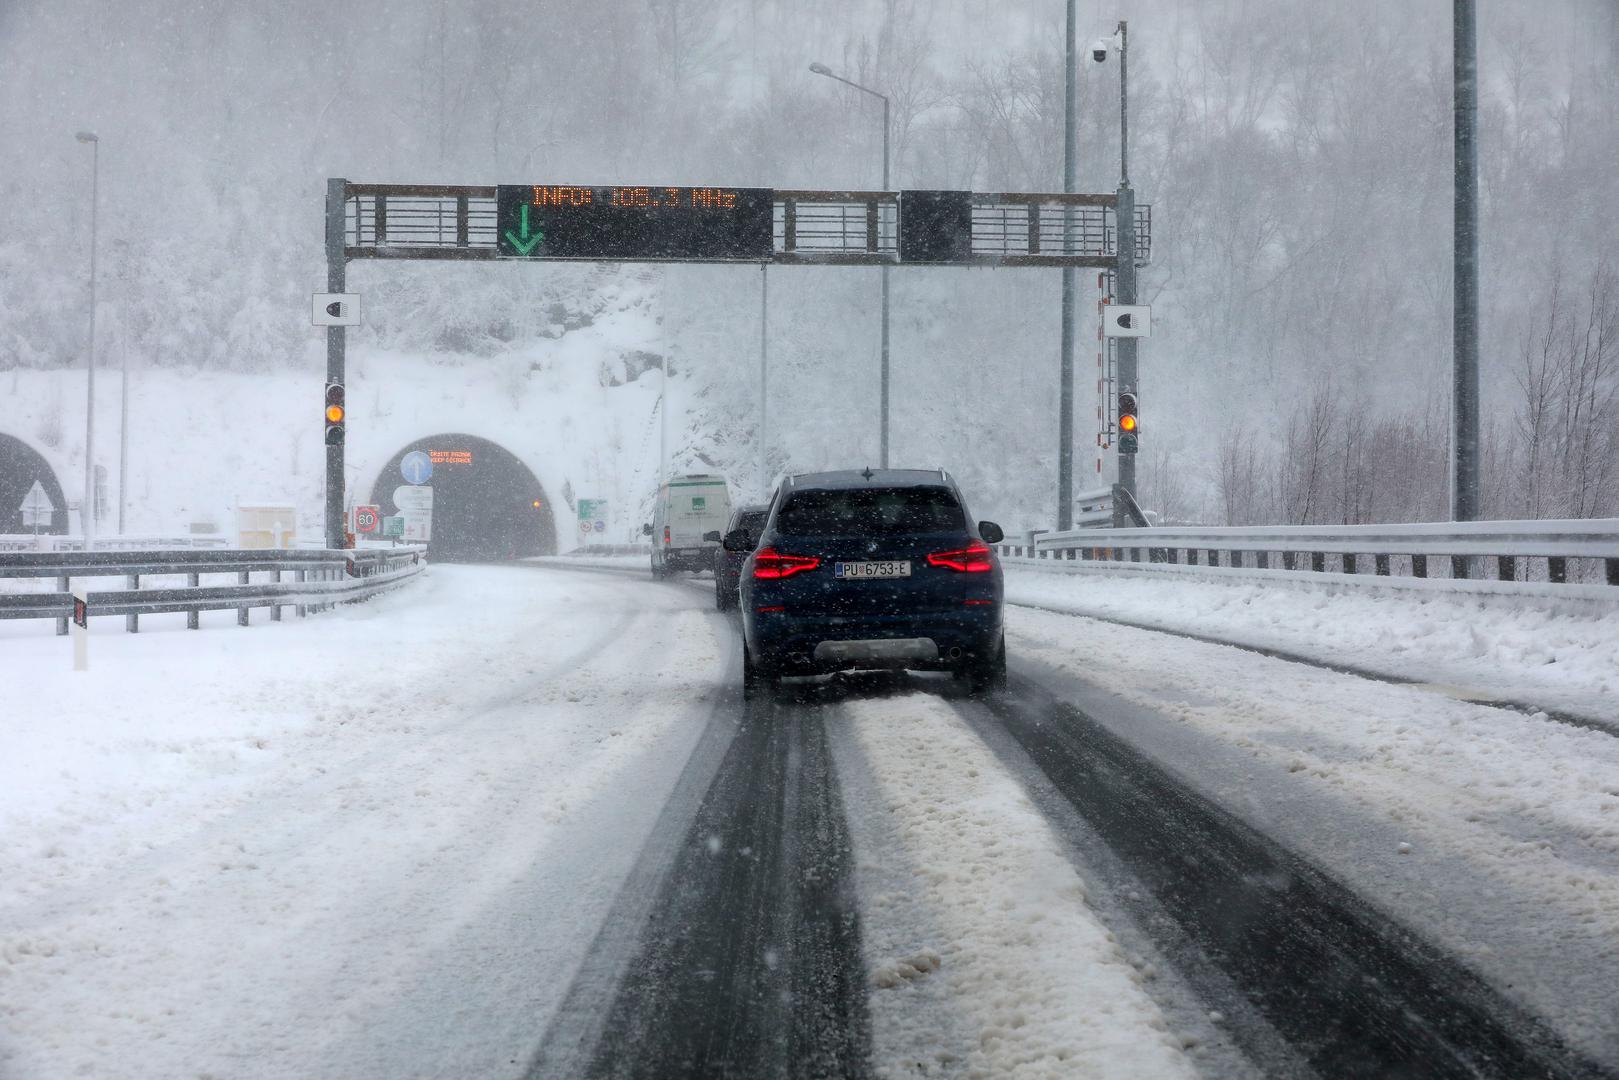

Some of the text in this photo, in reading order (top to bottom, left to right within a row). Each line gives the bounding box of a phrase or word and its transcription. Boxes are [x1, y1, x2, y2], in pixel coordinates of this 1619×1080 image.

[533, 187, 592, 206] INFO:
[692, 189, 736, 207] MHz
[358, 514, 374, 525] 60
[844, 562, 906, 576] PU 6753-E
